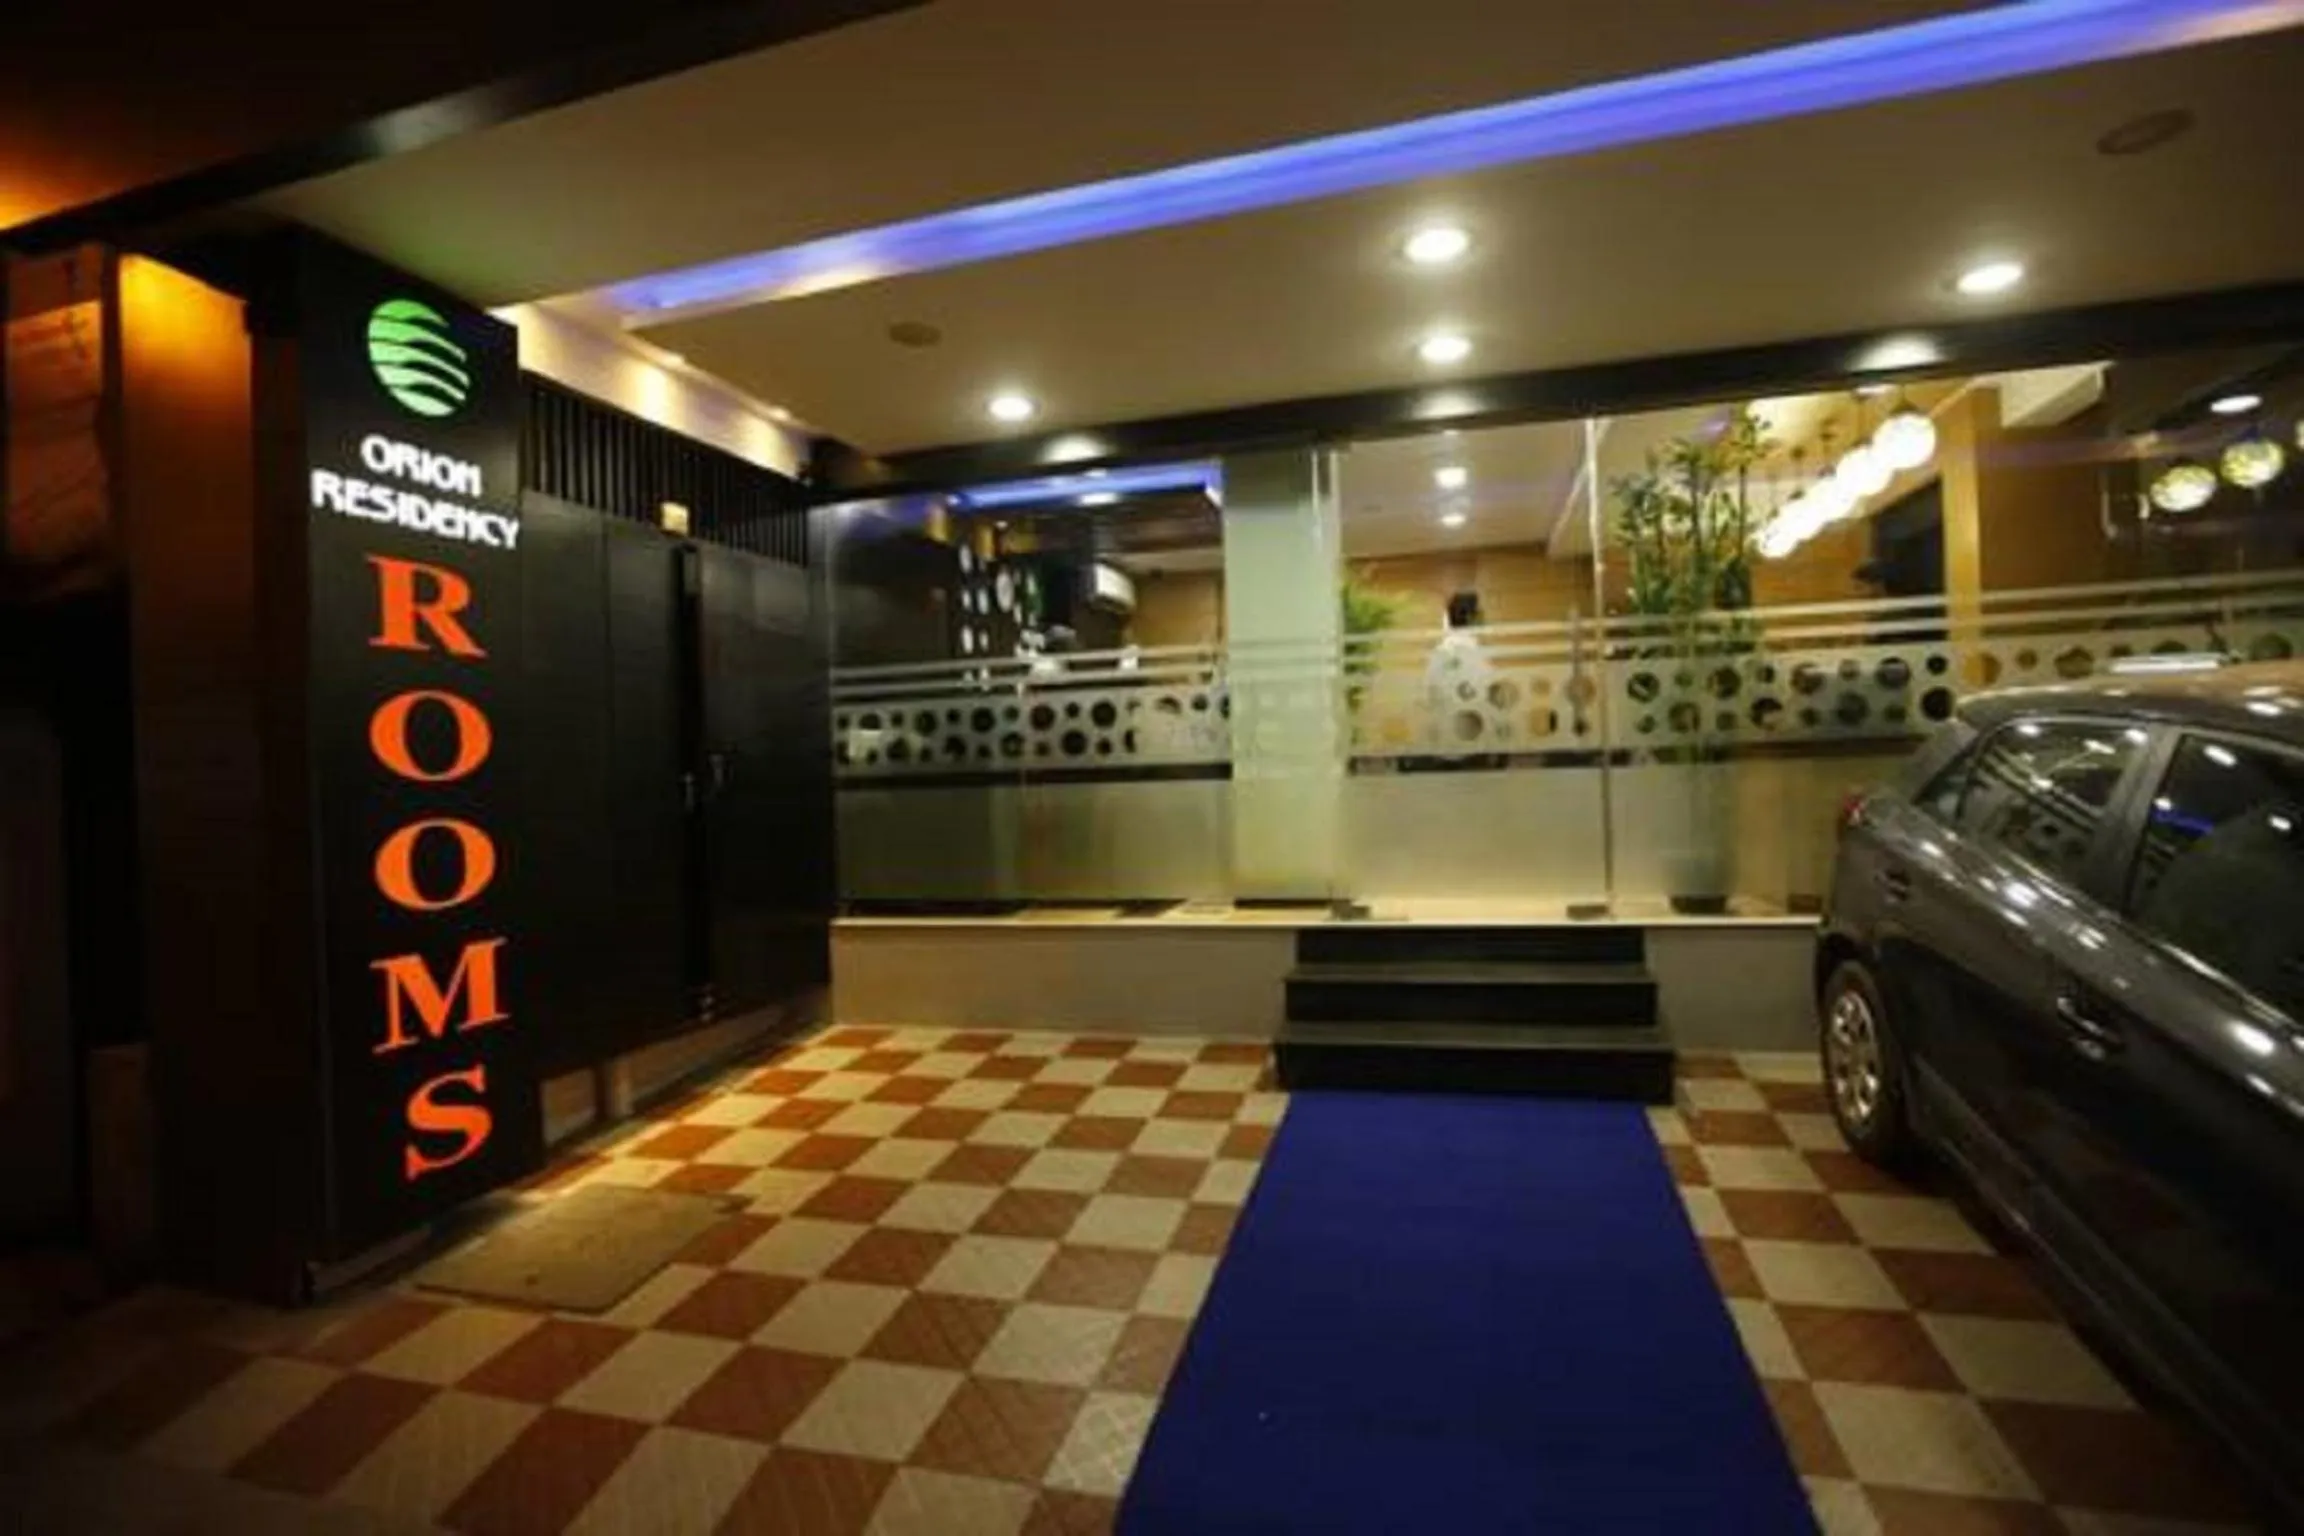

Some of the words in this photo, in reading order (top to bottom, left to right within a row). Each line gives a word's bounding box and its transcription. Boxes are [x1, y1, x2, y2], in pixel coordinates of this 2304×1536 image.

[359, 434, 483, 499] ORION
[310, 468, 520, 550] RESIDENCY
[366, 553, 508, 1181] ROOMS
